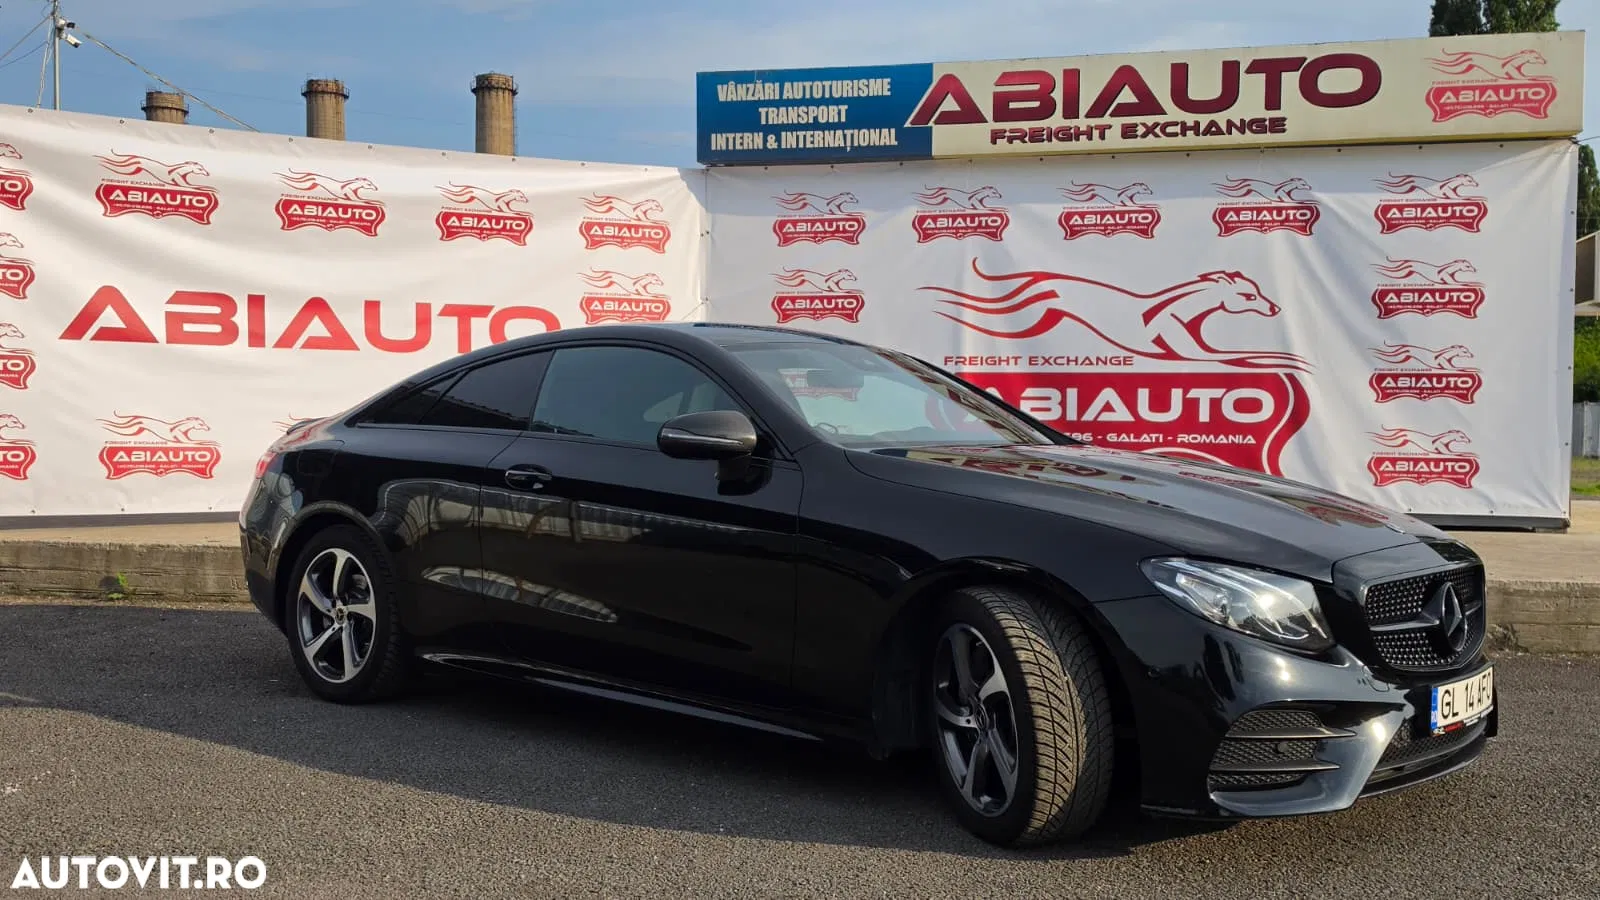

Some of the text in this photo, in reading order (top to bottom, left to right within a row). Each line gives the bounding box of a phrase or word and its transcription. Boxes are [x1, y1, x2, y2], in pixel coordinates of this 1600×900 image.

[717, 78, 891, 102] VÂNZĂRI AUTOTURISME
[905, 53, 1383, 127] ABIAUTO
[1439, 86, 1547, 104] ABIAUTO
[759, 105, 848, 125] TRANSPORT
[990, 116, 1287, 145] FREIGHT EXCHANGE
[711, 132, 763, 151] INTERN
[767, 135, 778, 149] &
[109, 189, 209, 207] ABIAUTO
[287, 203, 377, 220] ABIAUTO
[1223, 209, 1311, 222] ABIAUTO
[1386, 205, 1479, 218] ABIAUTO
[447, 215, 525, 230] ABIAUTO
[922, 216, 1002, 228] ABIAUTO
[1069, 212, 1153, 225] ABIAUTO
[590, 225, 664, 239] ABIAUTO
[783, 221, 859, 233] ABIAUTO
[781, 298, 858, 309] ABIAUTO
[1383, 291, 1476, 303] ABIAUTO
[590, 300, 664, 313] ABIAUTO
[58, 284, 562, 354] ABIAUTO
[944, 355, 1134, 366] FREIGHT EXCHANGE
[1381, 376, 1473, 388] ABIAUTO
[1106, 432, 1163, 443] GALATI
[1176, 433, 1257, 444] ROMANIA
[112, 450, 211, 463] ABIAUTO
[1379, 460, 1471, 473] ABIAUTO
[1441, 687, 1459, 720] GL
[1465, 681, 1474, 713] 14
